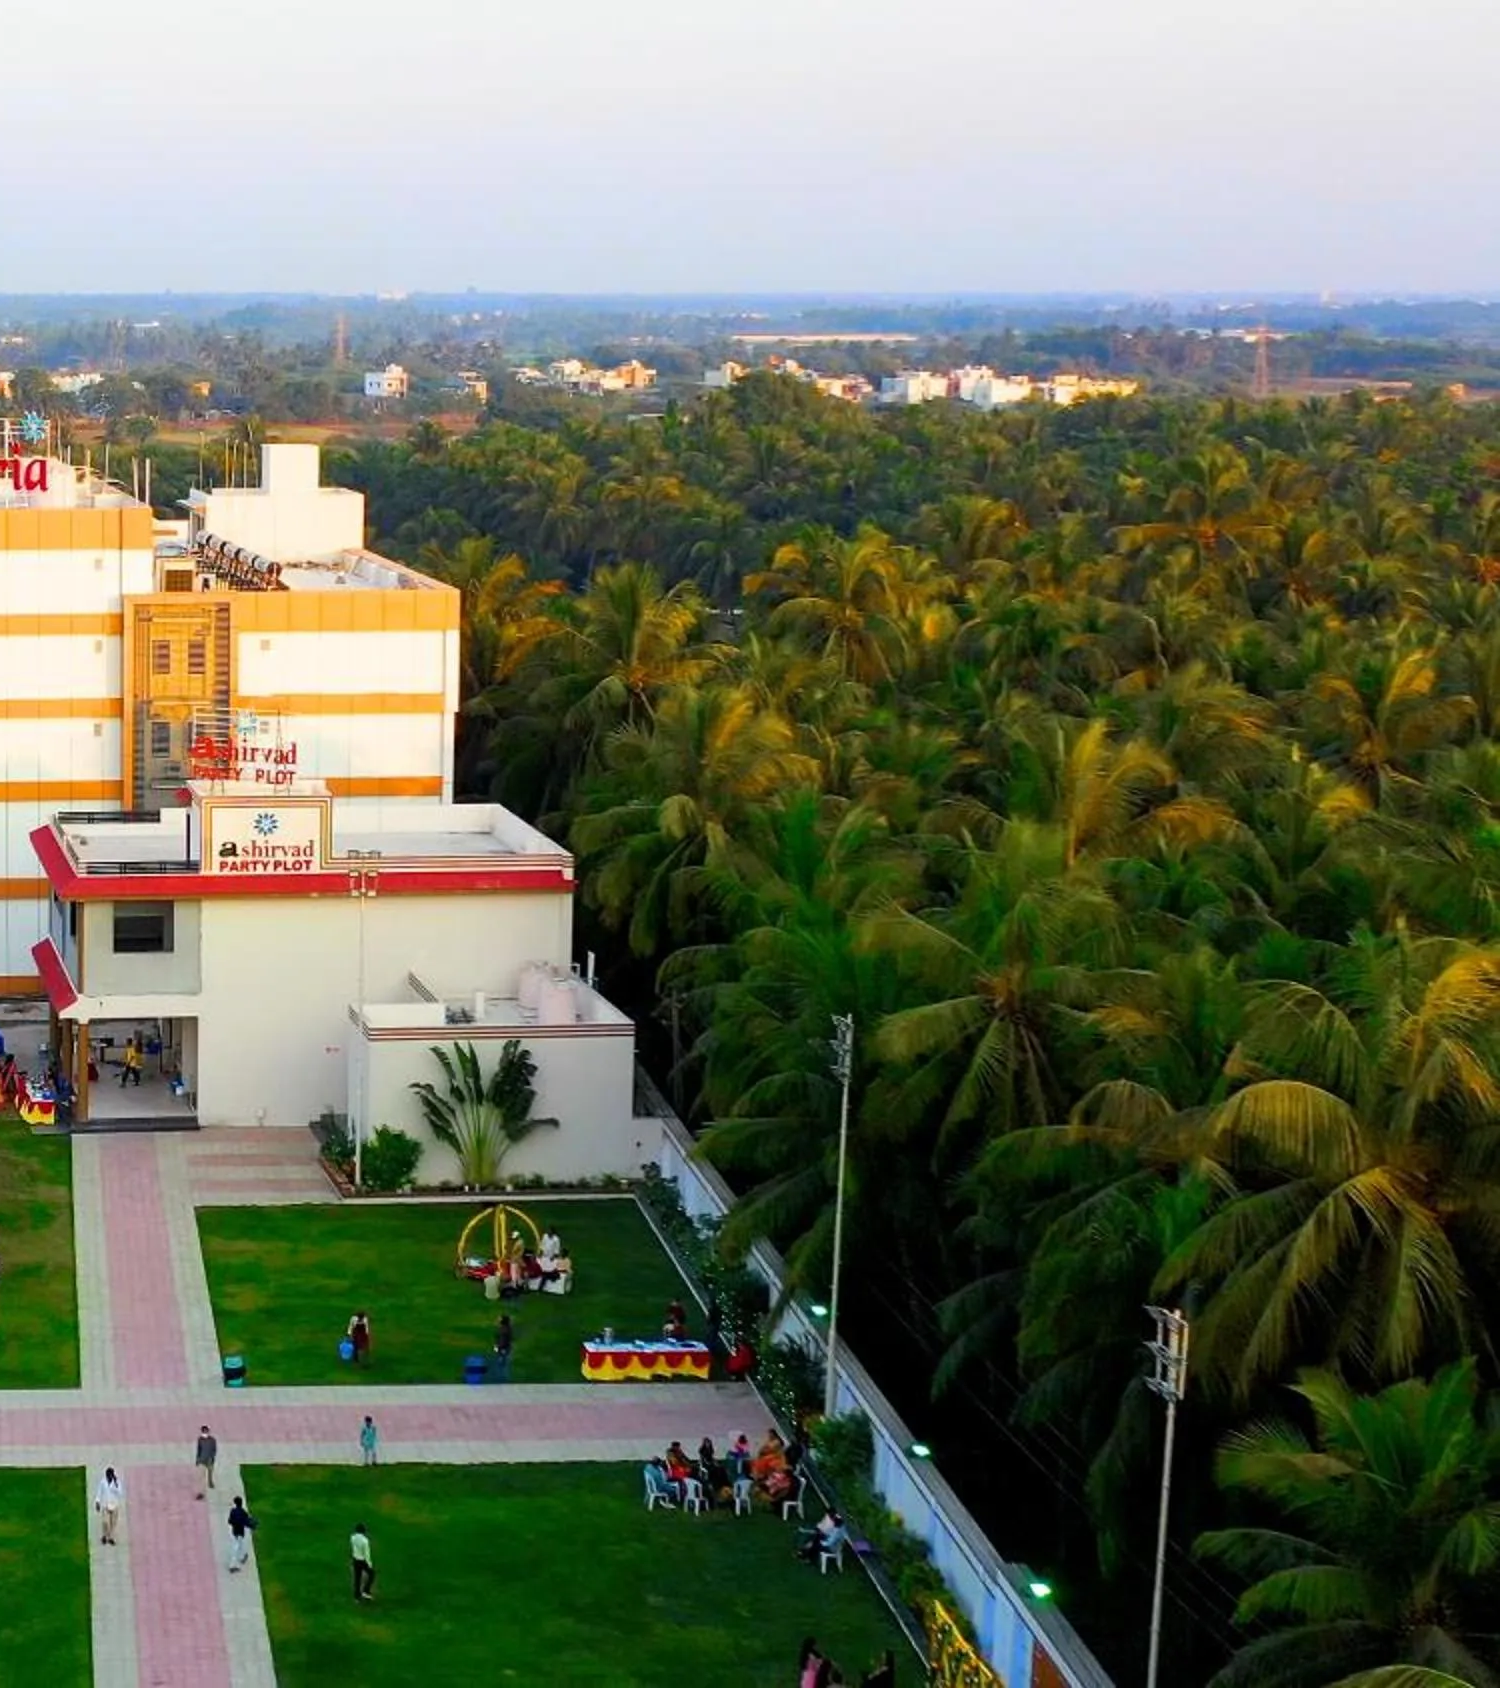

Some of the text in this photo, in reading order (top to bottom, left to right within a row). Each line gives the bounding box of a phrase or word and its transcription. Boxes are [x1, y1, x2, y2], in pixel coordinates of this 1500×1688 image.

[256, 768, 296, 784] PLOT
[218, 840, 314, 858] ashirvad
[220, 860, 313, 872] PARTY PLOT
